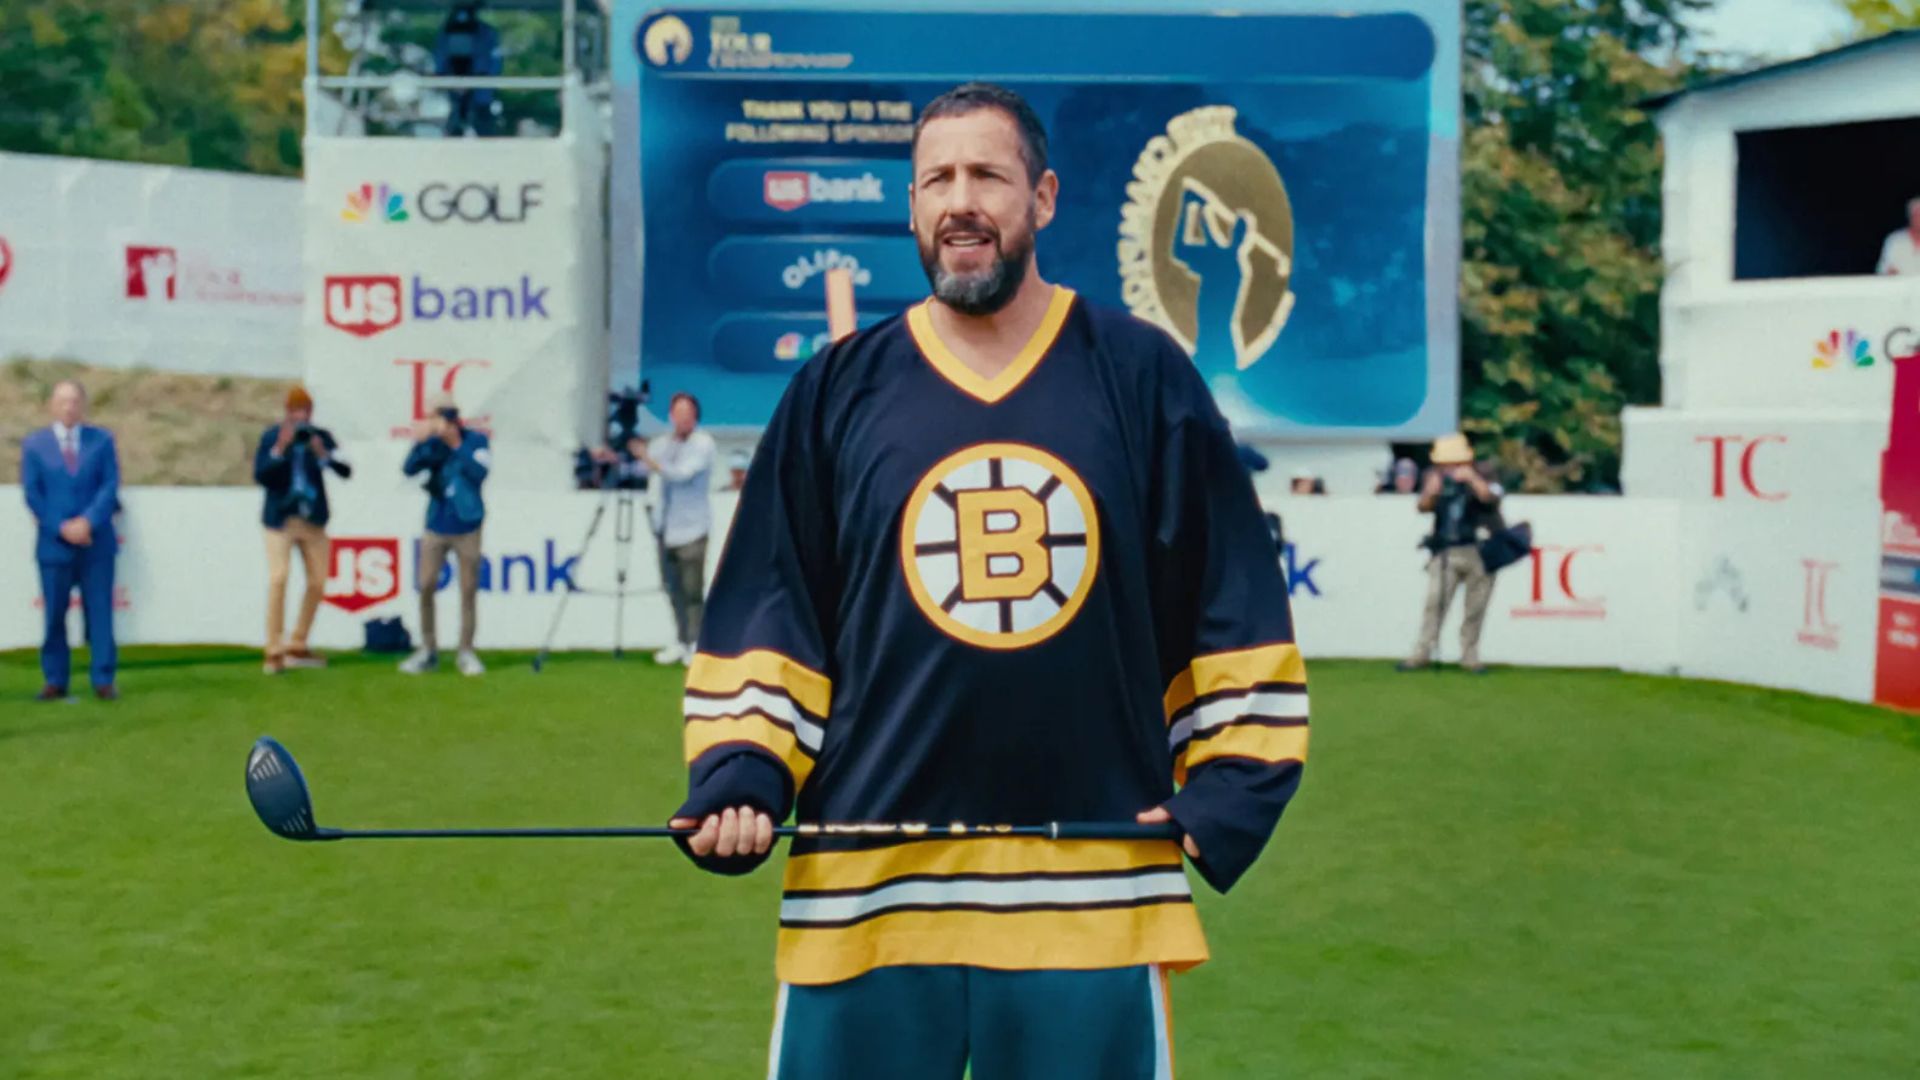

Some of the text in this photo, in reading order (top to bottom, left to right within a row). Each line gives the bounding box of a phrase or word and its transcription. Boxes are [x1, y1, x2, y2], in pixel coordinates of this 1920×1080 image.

[808, 101, 846, 120] YOU
[849, 101, 874, 120] TO
[877, 101, 912, 120] THE
[417, 182, 543, 224] GOLF
[809, 172, 884, 202] bank
[412, 275, 550, 320] bank
[1695, 435, 1791, 500] TC
[956, 485, 1053, 603] B
